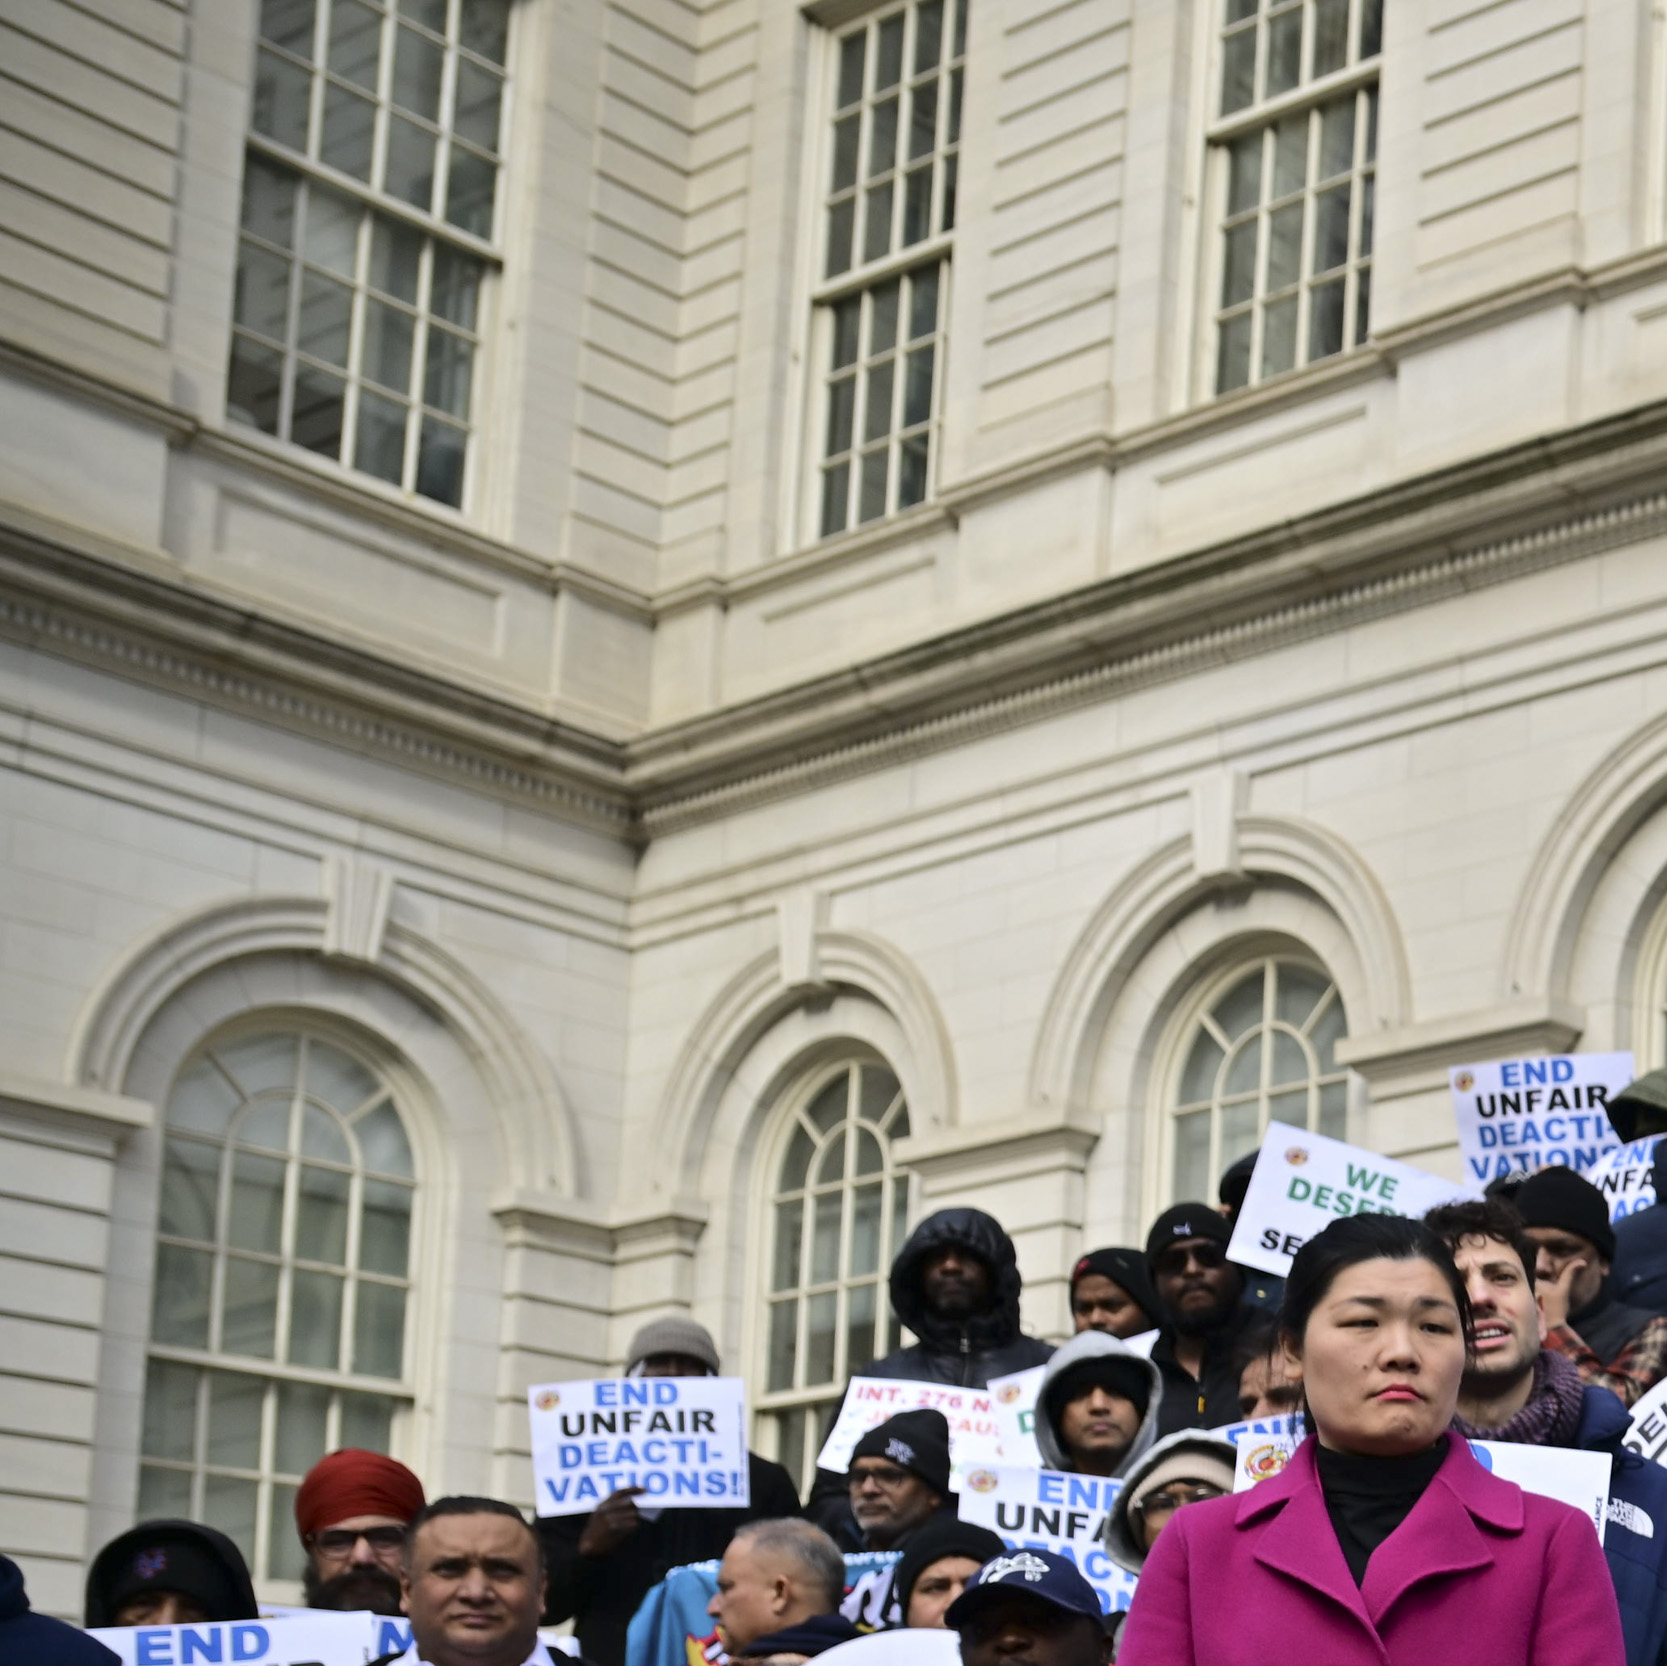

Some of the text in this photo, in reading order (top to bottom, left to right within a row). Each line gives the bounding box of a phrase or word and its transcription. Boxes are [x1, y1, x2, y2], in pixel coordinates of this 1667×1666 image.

[1501, 1059, 1574, 1088] END
[1476, 1085, 1608, 1118] UNFAIR
[1346, 1163, 1398, 1200] WE
[595, 1382, 678, 1406] END
[857, 1385, 963, 1408] INT. 276
[561, 1411, 716, 1437] UNFAIR
[559, 1440, 723, 1470] DEACTI-
[546, 1470, 739, 1502] VATIONS!
[136, 1625, 270, 1666] END
